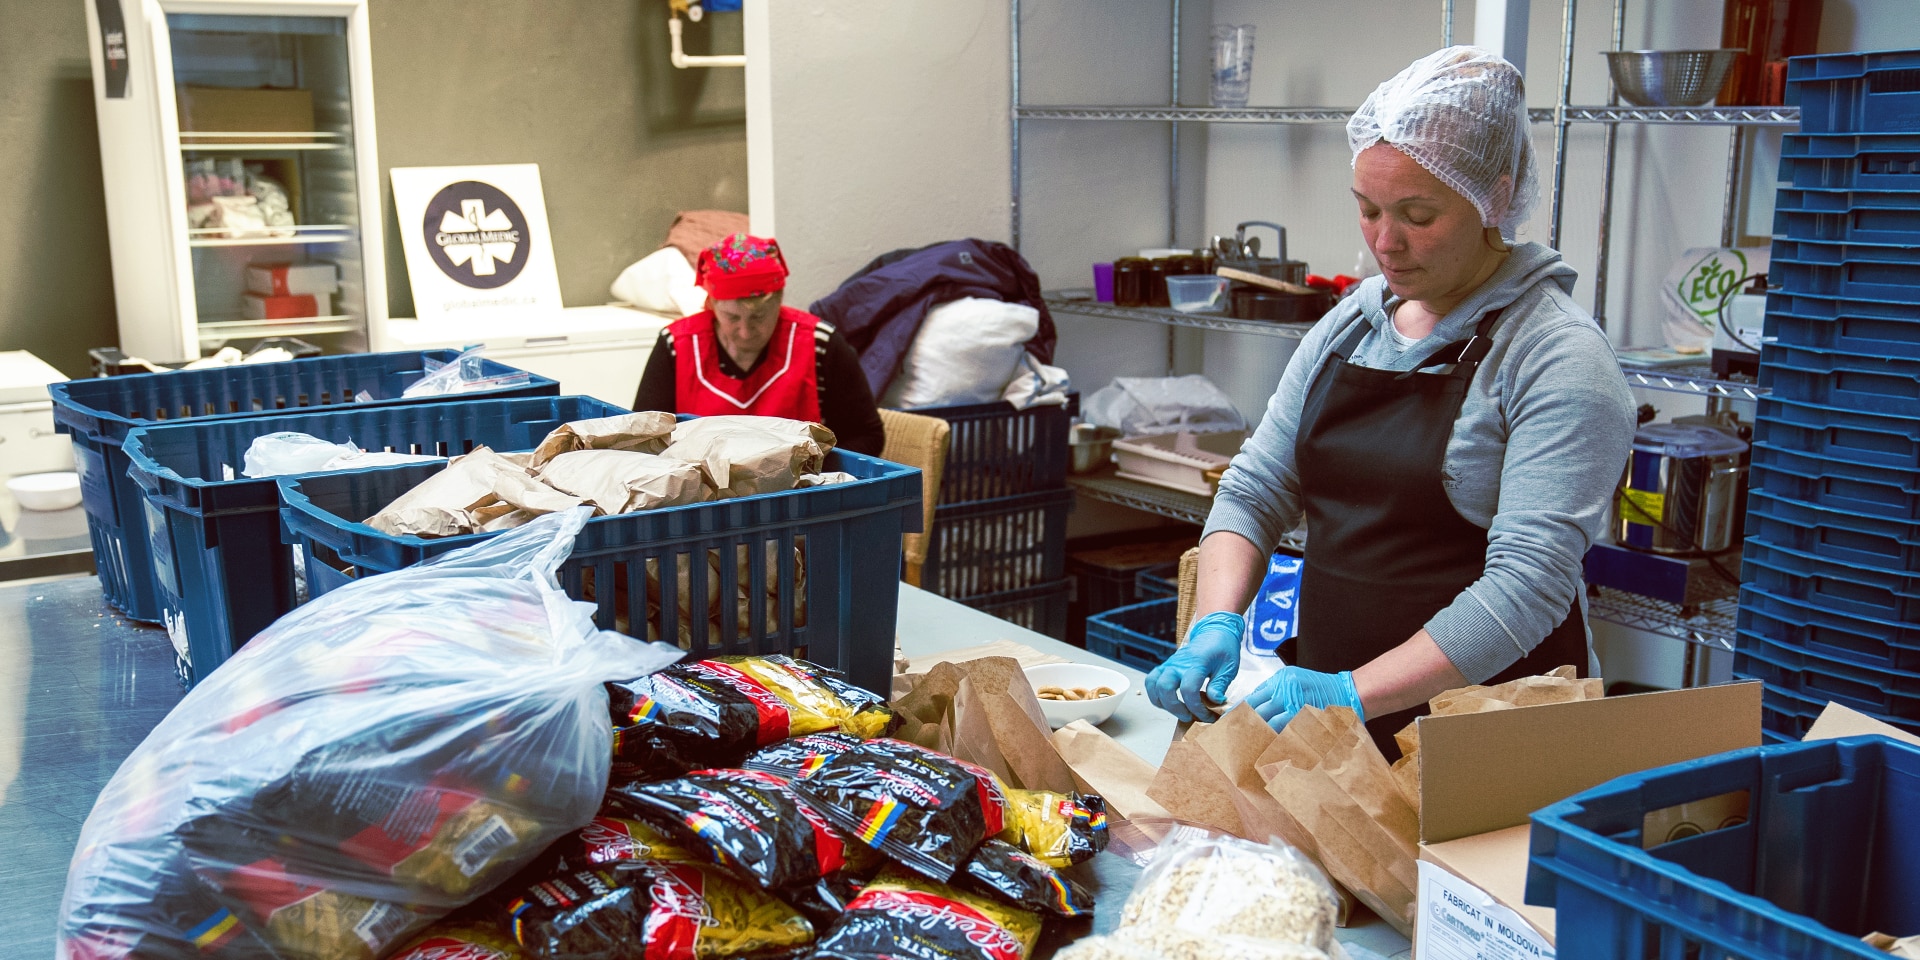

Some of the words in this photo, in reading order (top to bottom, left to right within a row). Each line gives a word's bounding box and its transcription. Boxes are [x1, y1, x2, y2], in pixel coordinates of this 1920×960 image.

[1690, 269, 1736, 304] ECO
[879, 777, 929, 807] PRODUS
[890, 768, 939, 796] MOLDOVA
[716, 793, 760, 824] MOLDO
[726, 785, 776, 819] PASTE
[1443, 889, 1481, 921] FABRICAT
[1484, 915, 1494, 929] IN
[1498, 923, 1540, 958] MOLDOVA
[901, 935, 958, 960] ASTE
